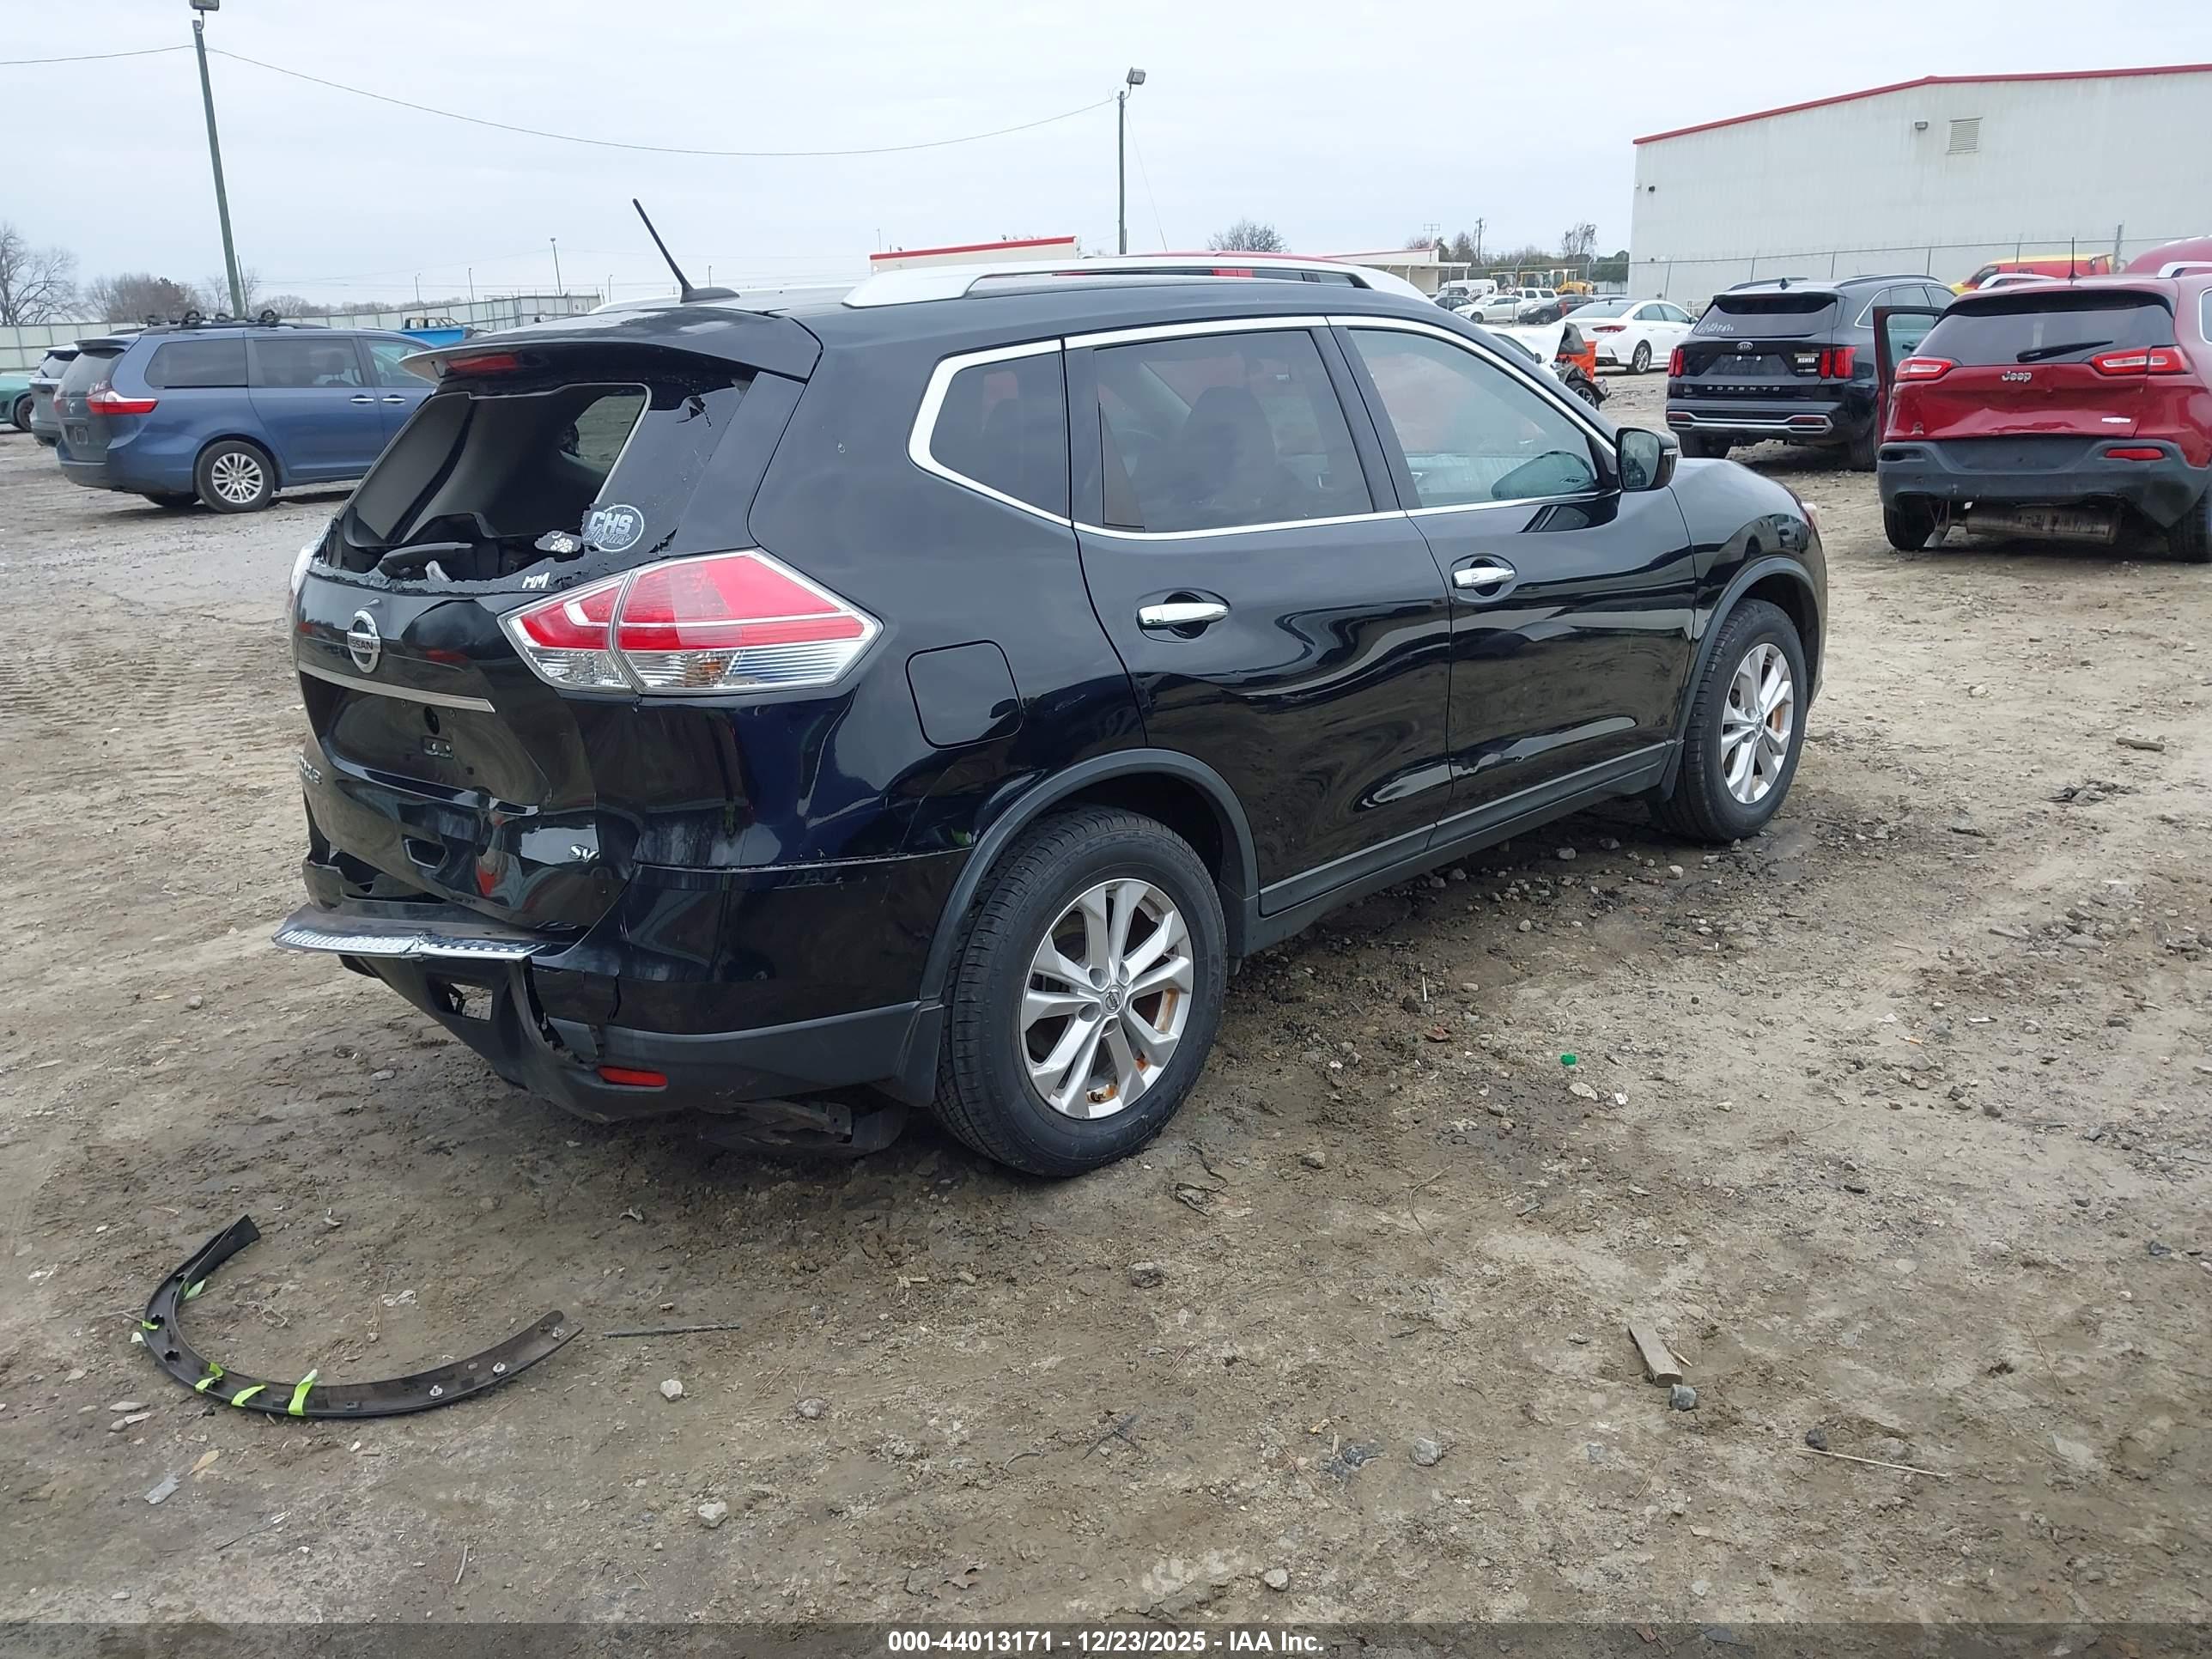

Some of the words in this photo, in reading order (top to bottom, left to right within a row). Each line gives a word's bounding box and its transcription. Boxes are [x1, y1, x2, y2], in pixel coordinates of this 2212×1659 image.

[2001, 370, 2033, 383] Jeep
[588, 511, 634, 535] CHS
[570, 844, 599, 862] SV
